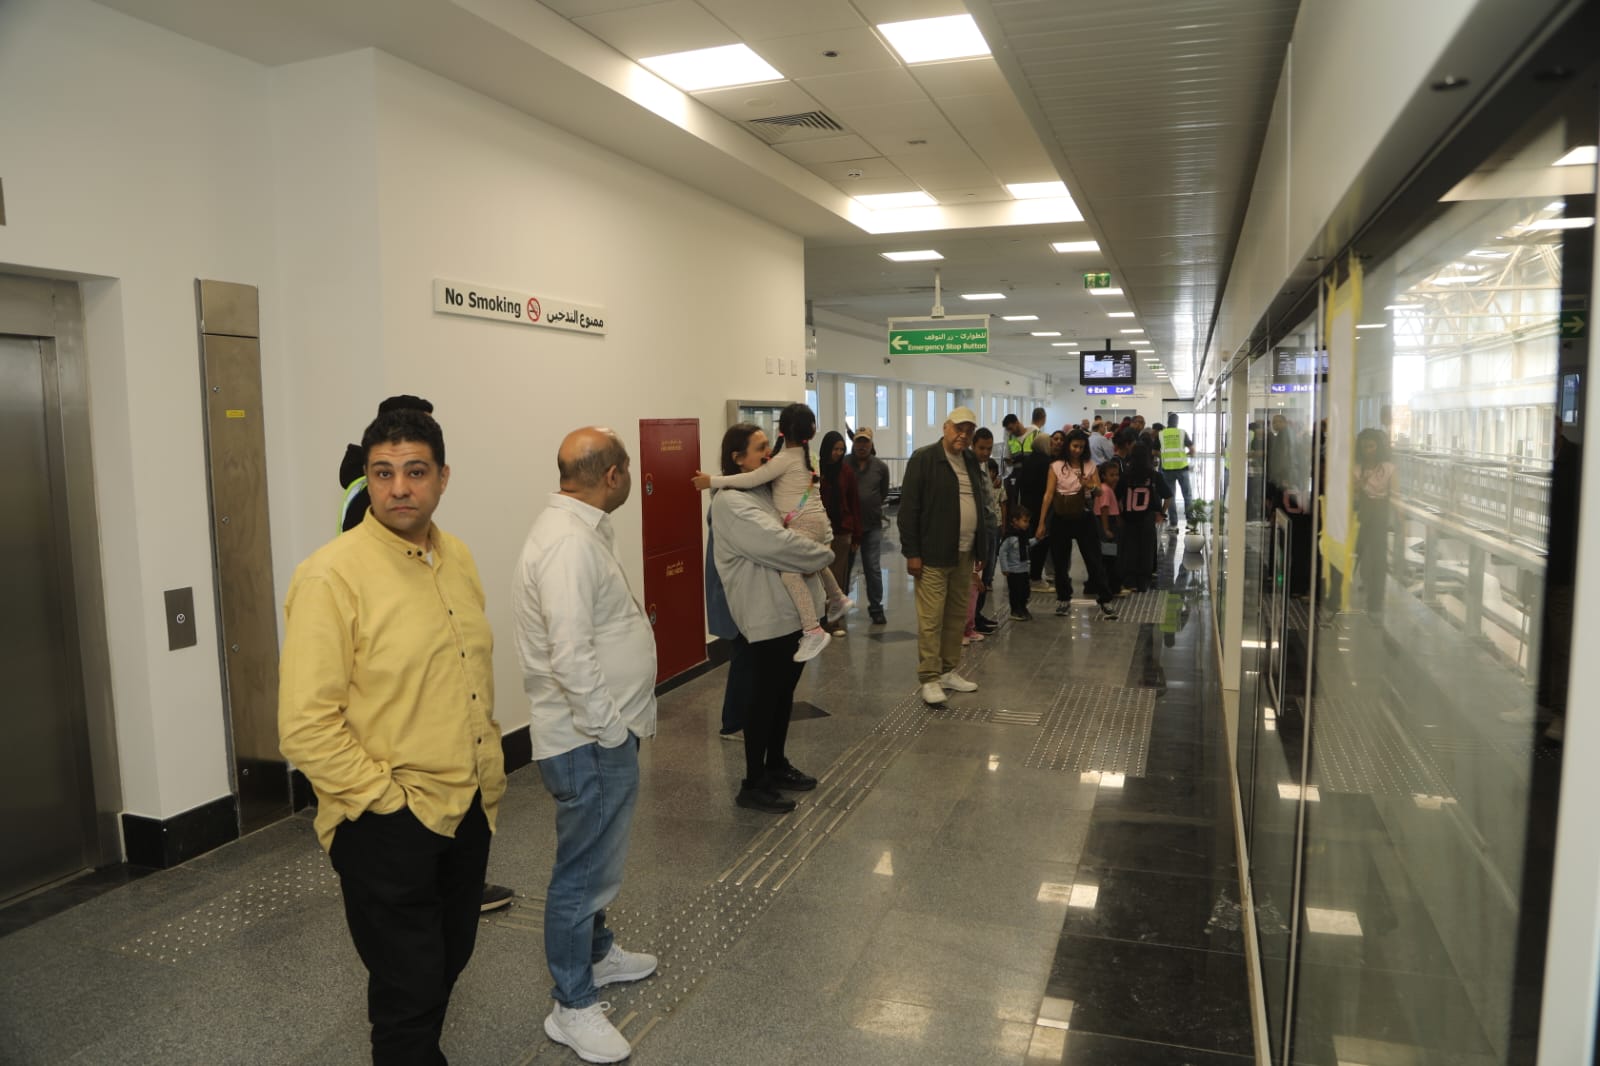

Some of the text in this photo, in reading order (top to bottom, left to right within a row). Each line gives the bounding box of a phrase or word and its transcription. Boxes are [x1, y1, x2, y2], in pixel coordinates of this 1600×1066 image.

[445, 287, 522, 318] No Smoking
[546, 309, 604, 328] ممنوع التدخين
[907, 342, 987, 352] Emergency Stop Button
[1127, 487, 1150, 512] 10
